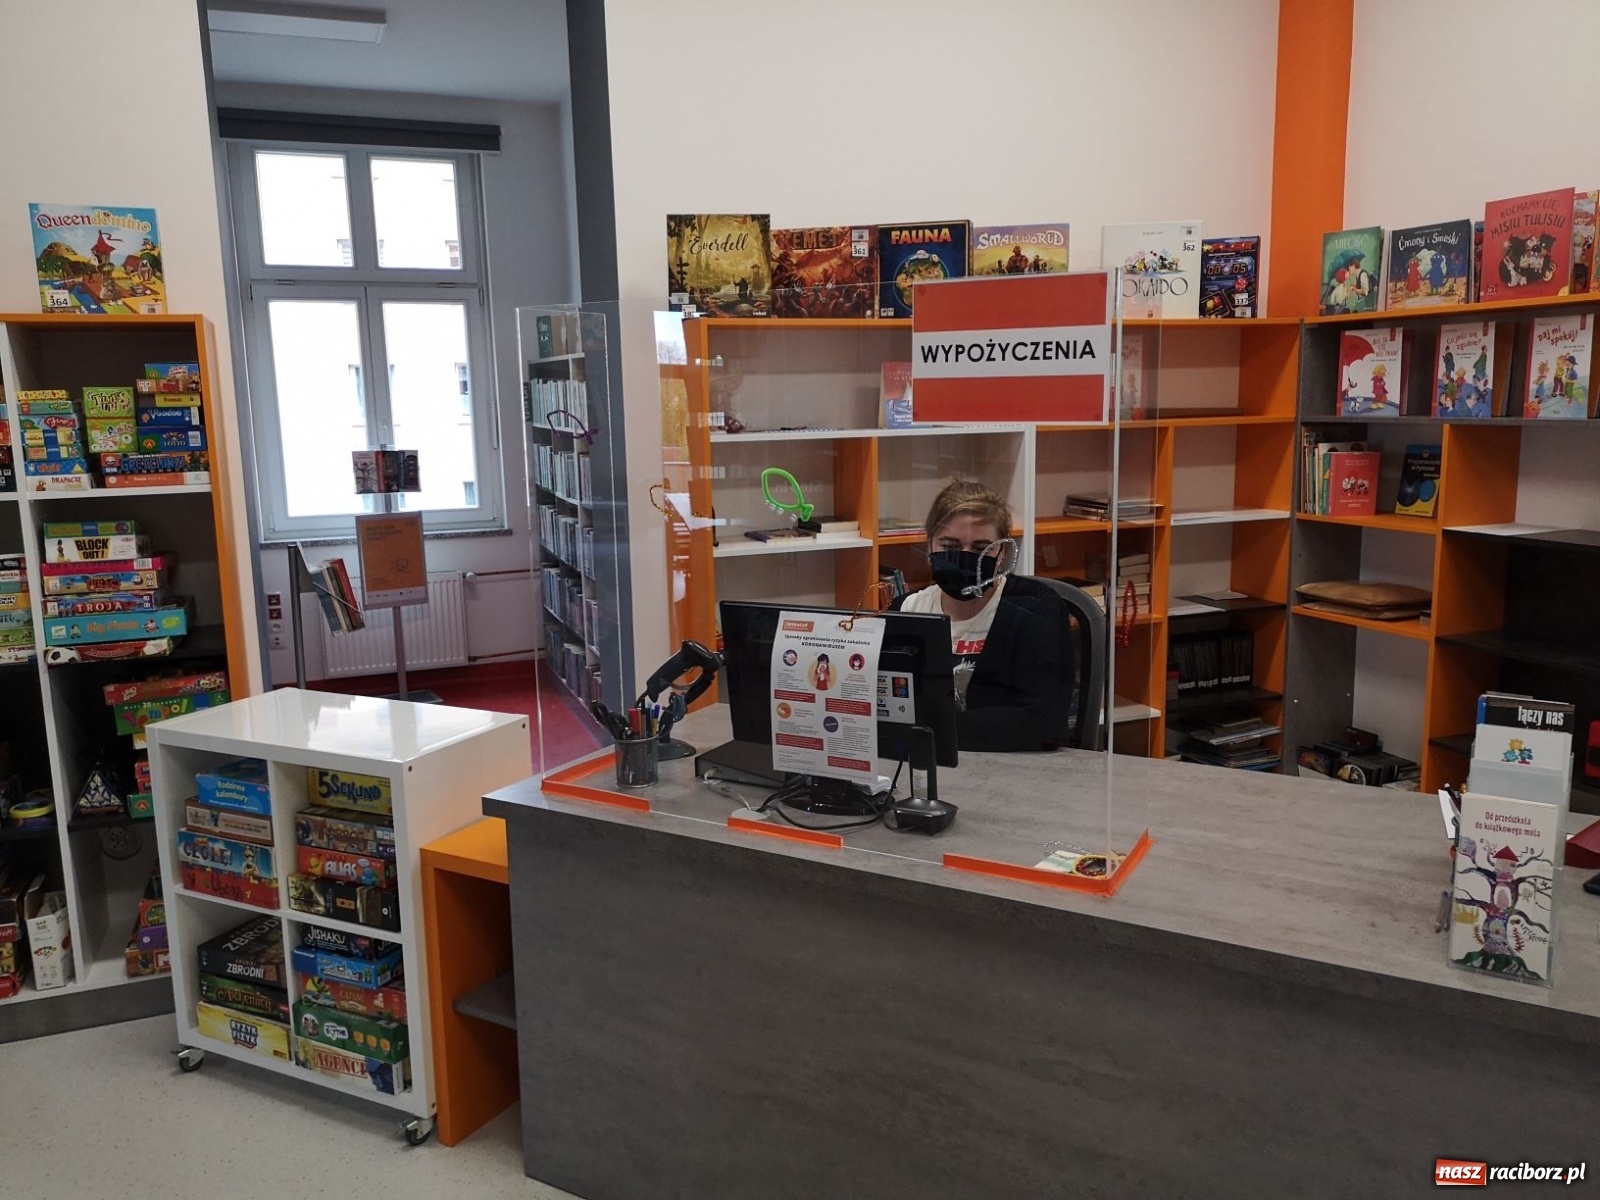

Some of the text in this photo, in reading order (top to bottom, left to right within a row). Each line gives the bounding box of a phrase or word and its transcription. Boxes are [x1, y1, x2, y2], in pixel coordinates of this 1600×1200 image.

[36, 208, 152, 233] Queendomino
[1524, 212, 1566, 228] TULISIU
[689, 233, 749, 255] Everdell
[776, 231, 841, 250] KEMET
[891, 228, 952, 244] FAUNA
[1122, 277, 1188, 298] OKAIDO
[50, 298, 69, 306] 364
[921, 339, 1096, 363] WYPOŻYCZENIA
[148, 409, 182, 420] Voodoo
[75, 538, 110, 551] BLOCK
[77, 602, 123, 613] TROJA
[1517, 705, 1564, 726] łączy nas
[318, 771, 333, 798] 5
[1485, 811, 1531, 826] Od przedszkola
[1475, 821, 1541, 837] do książkowego mola
[325, 860, 358, 879] ALIAS
[308, 926, 346, 944] JISHAKU
[226, 963, 264, 979] ZBRODNI
[230, 1020, 258, 1033] RYZYK
